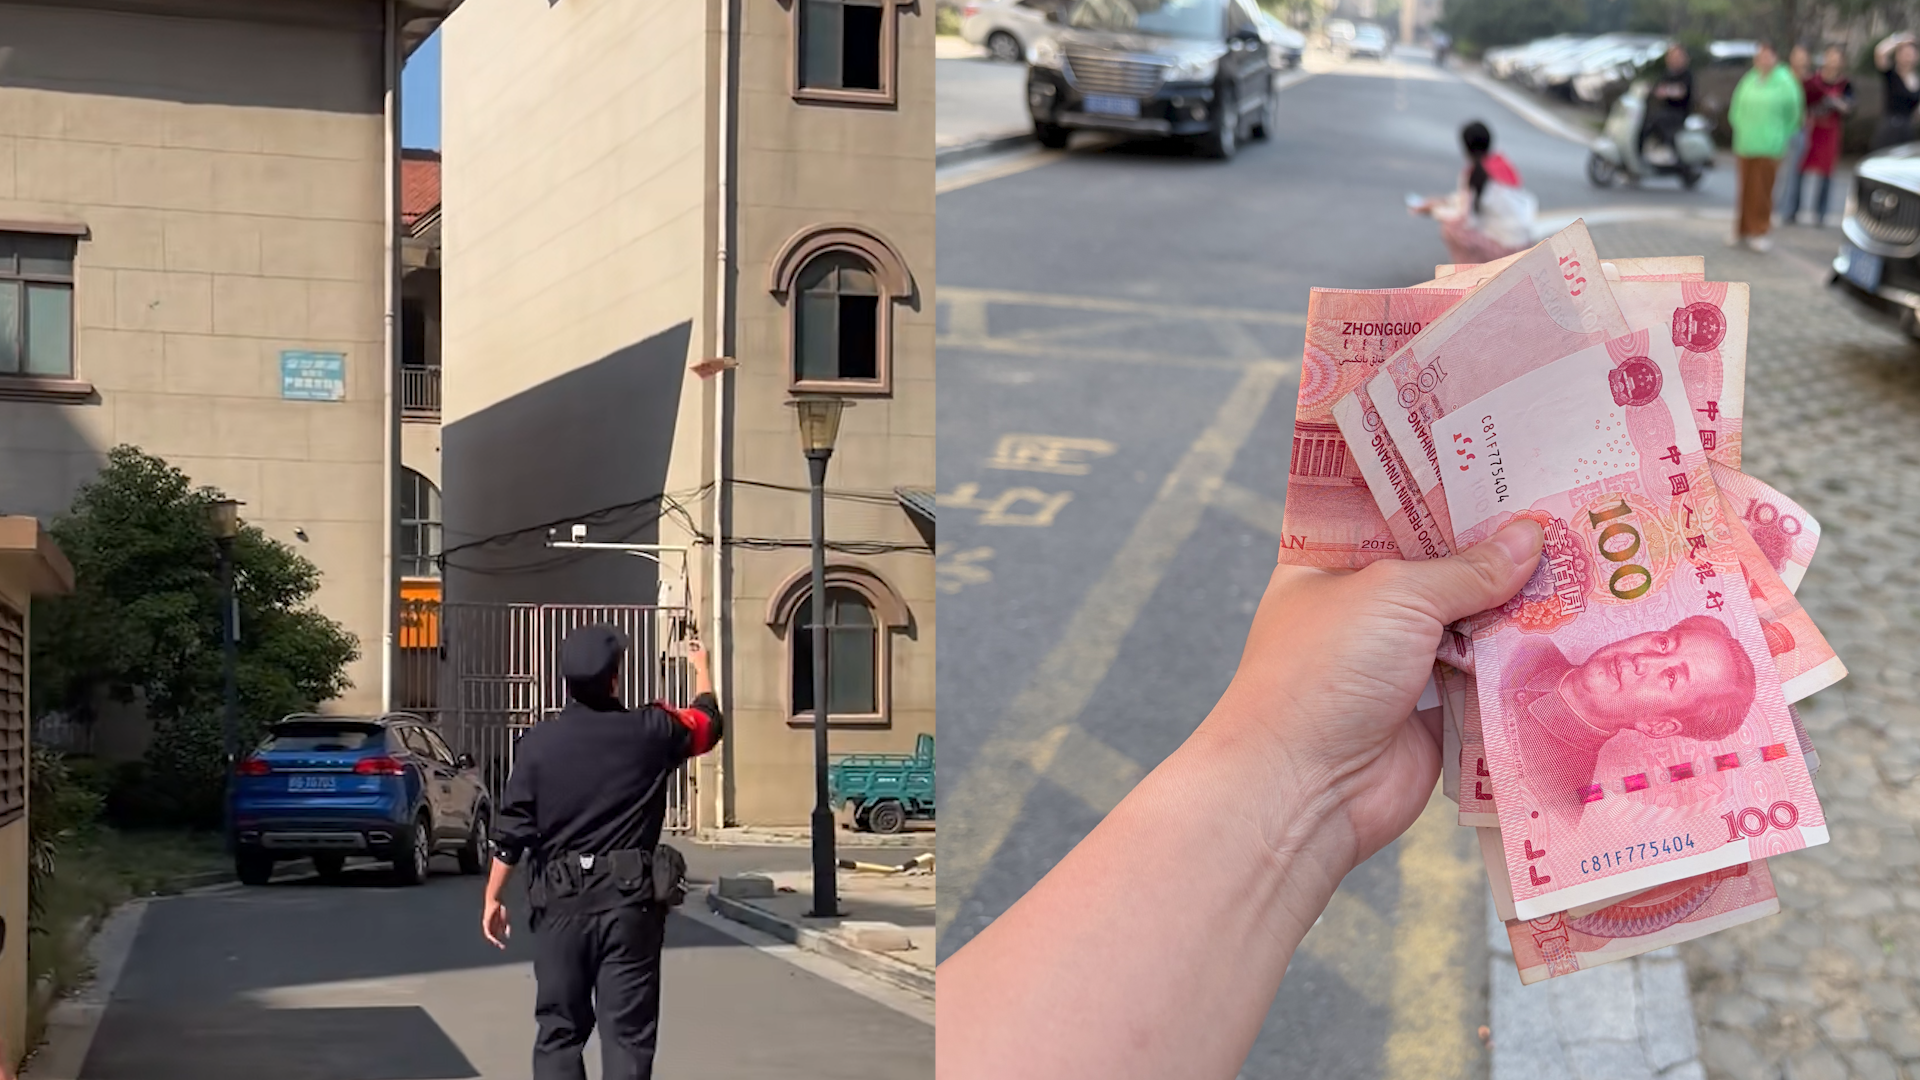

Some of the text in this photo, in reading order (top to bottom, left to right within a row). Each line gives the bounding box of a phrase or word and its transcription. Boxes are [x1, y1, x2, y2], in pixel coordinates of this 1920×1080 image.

[1342, 322, 1421, 336] ZHONGGUO
[1397, 356, 1448, 408] 100
[1408, 411, 1439, 466] YINHANG
[1696, 401, 1718, 450] 中国
[1371, 434, 1404, 490] YINHANG
[1482, 415, 1509, 503] C81F775404
[1398, 486, 1424, 532] RENMIN
[1659, 446, 1724, 612] 中国人民银行
[1740, 498, 1802, 537] 100
[1361, 540, 1400, 550] 2015
[1589, 499, 1652, 600] 100
[1720, 800, 1798, 843] 100
[1581, 833, 1694, 874] C81F775404
